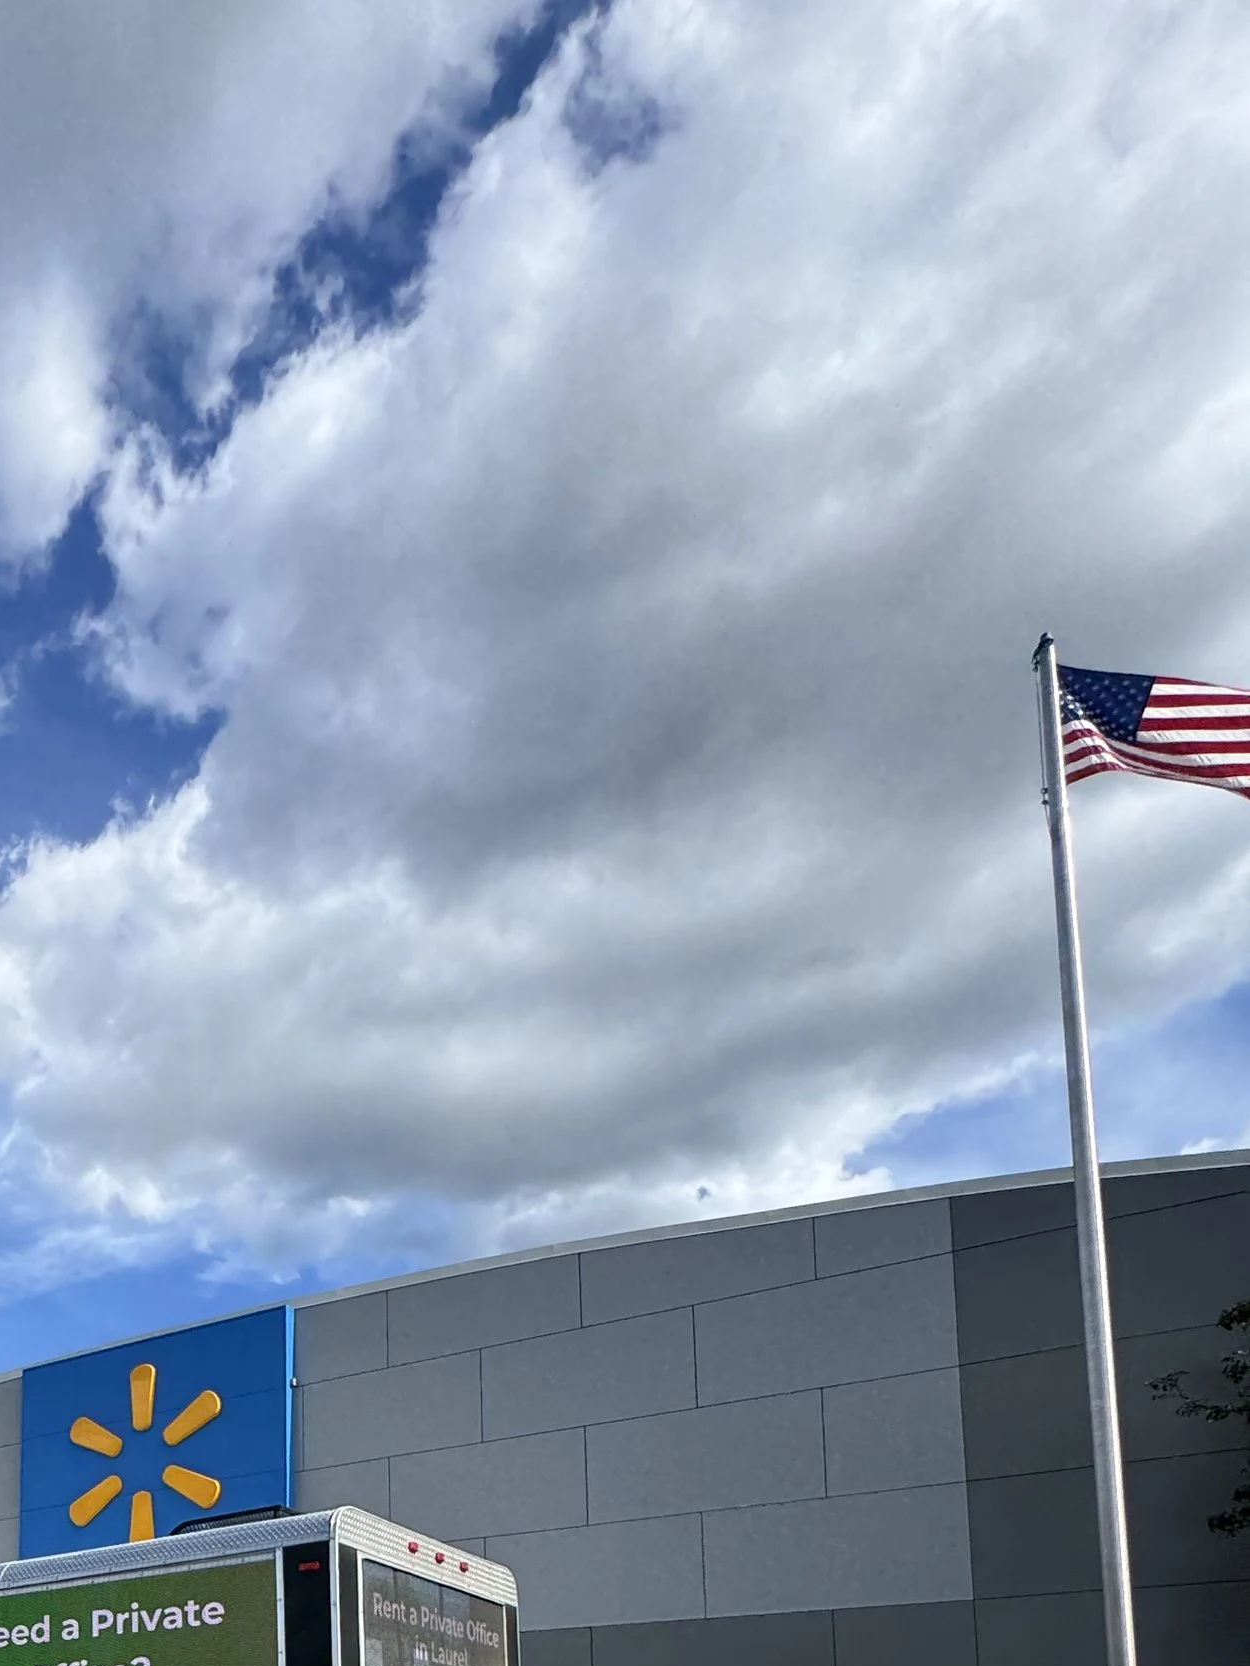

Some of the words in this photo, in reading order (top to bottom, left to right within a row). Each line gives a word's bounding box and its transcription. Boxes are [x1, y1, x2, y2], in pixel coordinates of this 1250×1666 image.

[61, 1618, 80, 1641] a
[91, 1600, 225, 1638] Private
[372, 1592, 407, 1623] Rent
[409, 1606, 418, 1626] a
[420, 1605, 465, 1639] Private
[466, 1619, 500, 1648] Office
[414, 1634, 429, 1661] in
